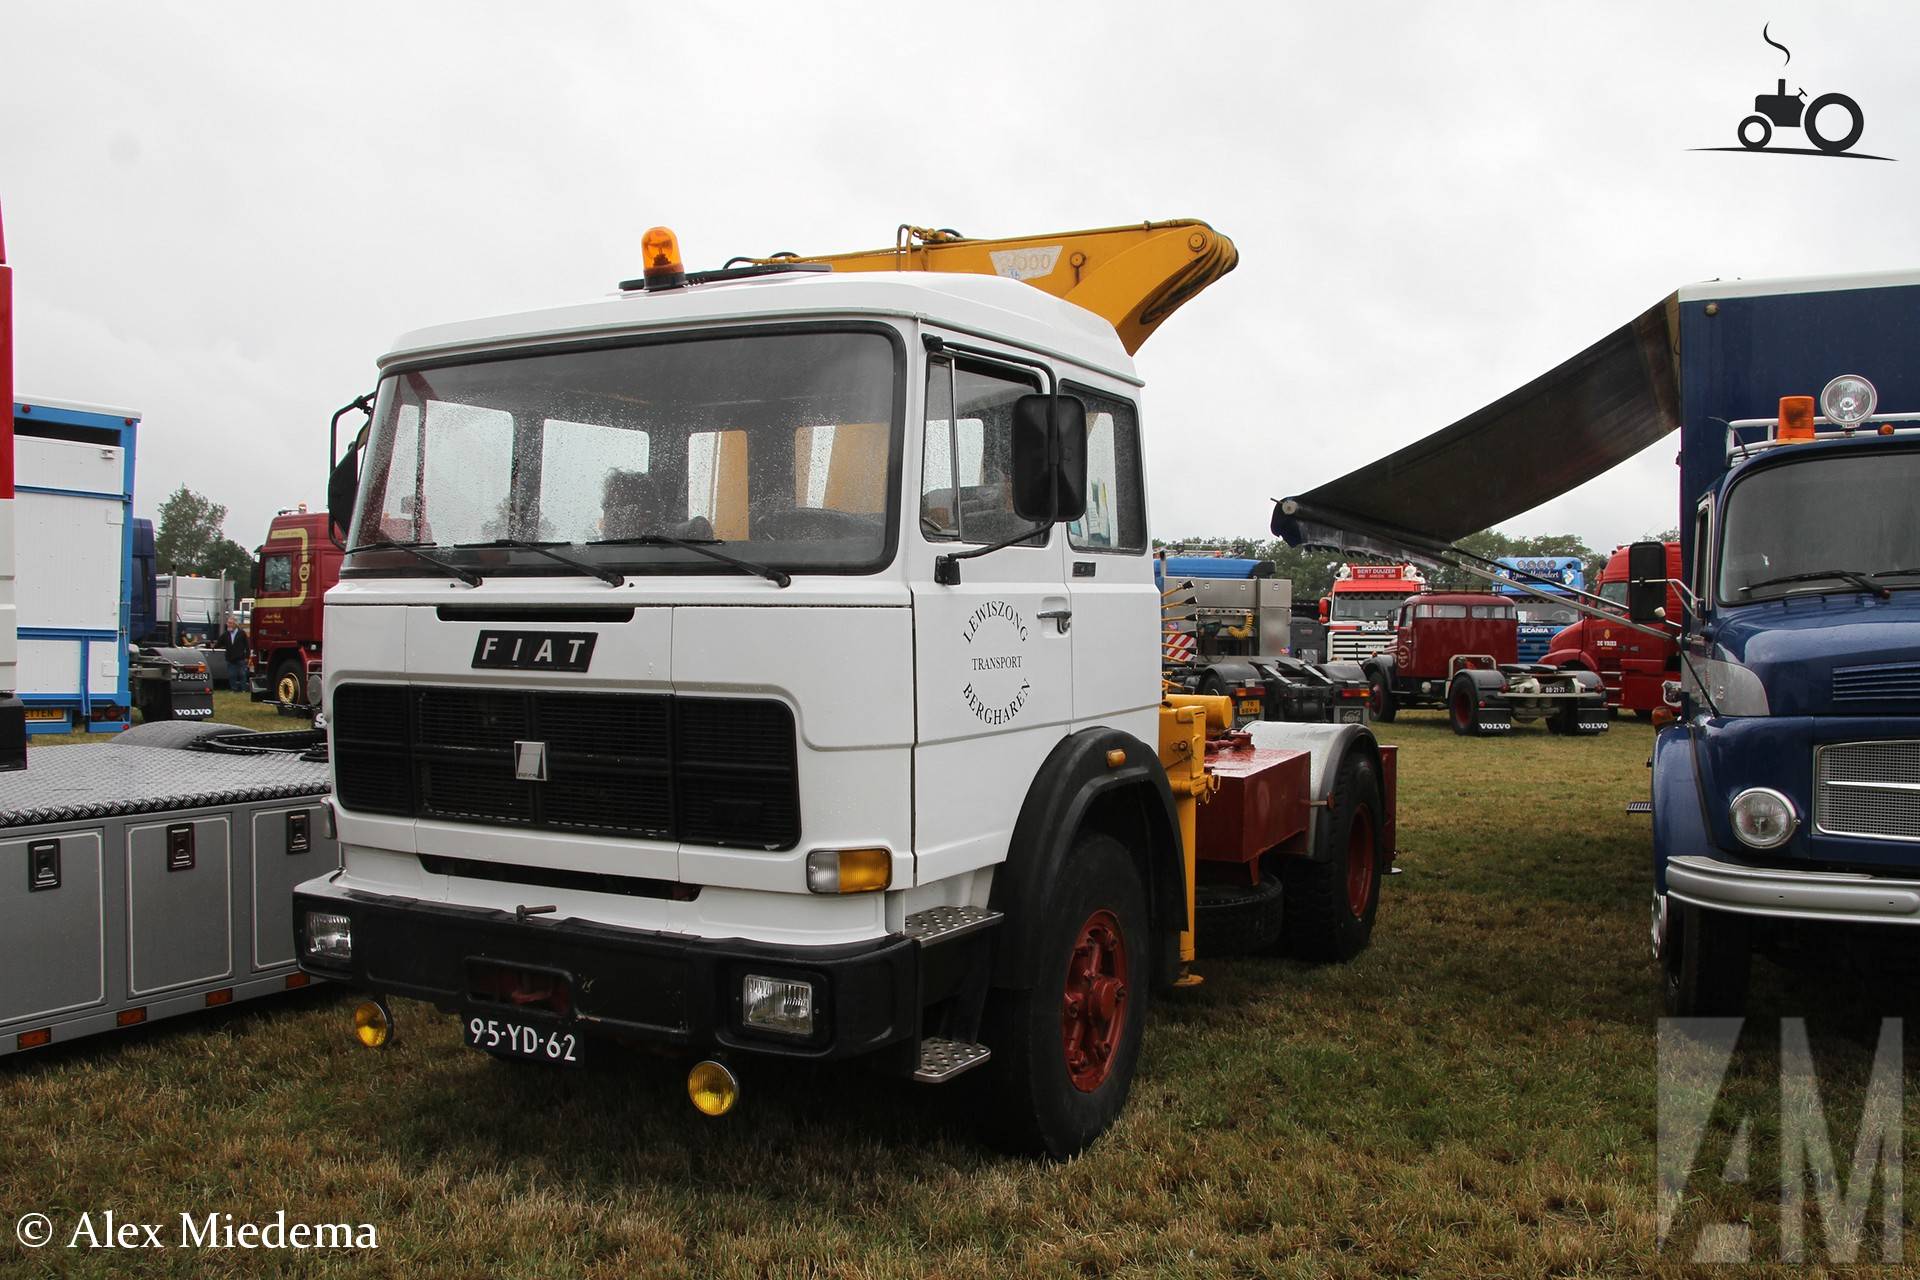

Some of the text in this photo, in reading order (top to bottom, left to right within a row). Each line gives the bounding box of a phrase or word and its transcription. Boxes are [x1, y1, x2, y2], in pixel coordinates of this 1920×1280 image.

[963, 601, 1029, 644] LEWISZONG
[481, 637, 586, 664] FIAT
[972, 655, 1023, 671] TRANSPORT
[178, 673, 208, 681] ASPEREN
[174, 708, 212, 717] VOLVO
[963, 678, 1030, 725] BERGHAREN
[470, 1017, 577, 1062] 95-YD-62
